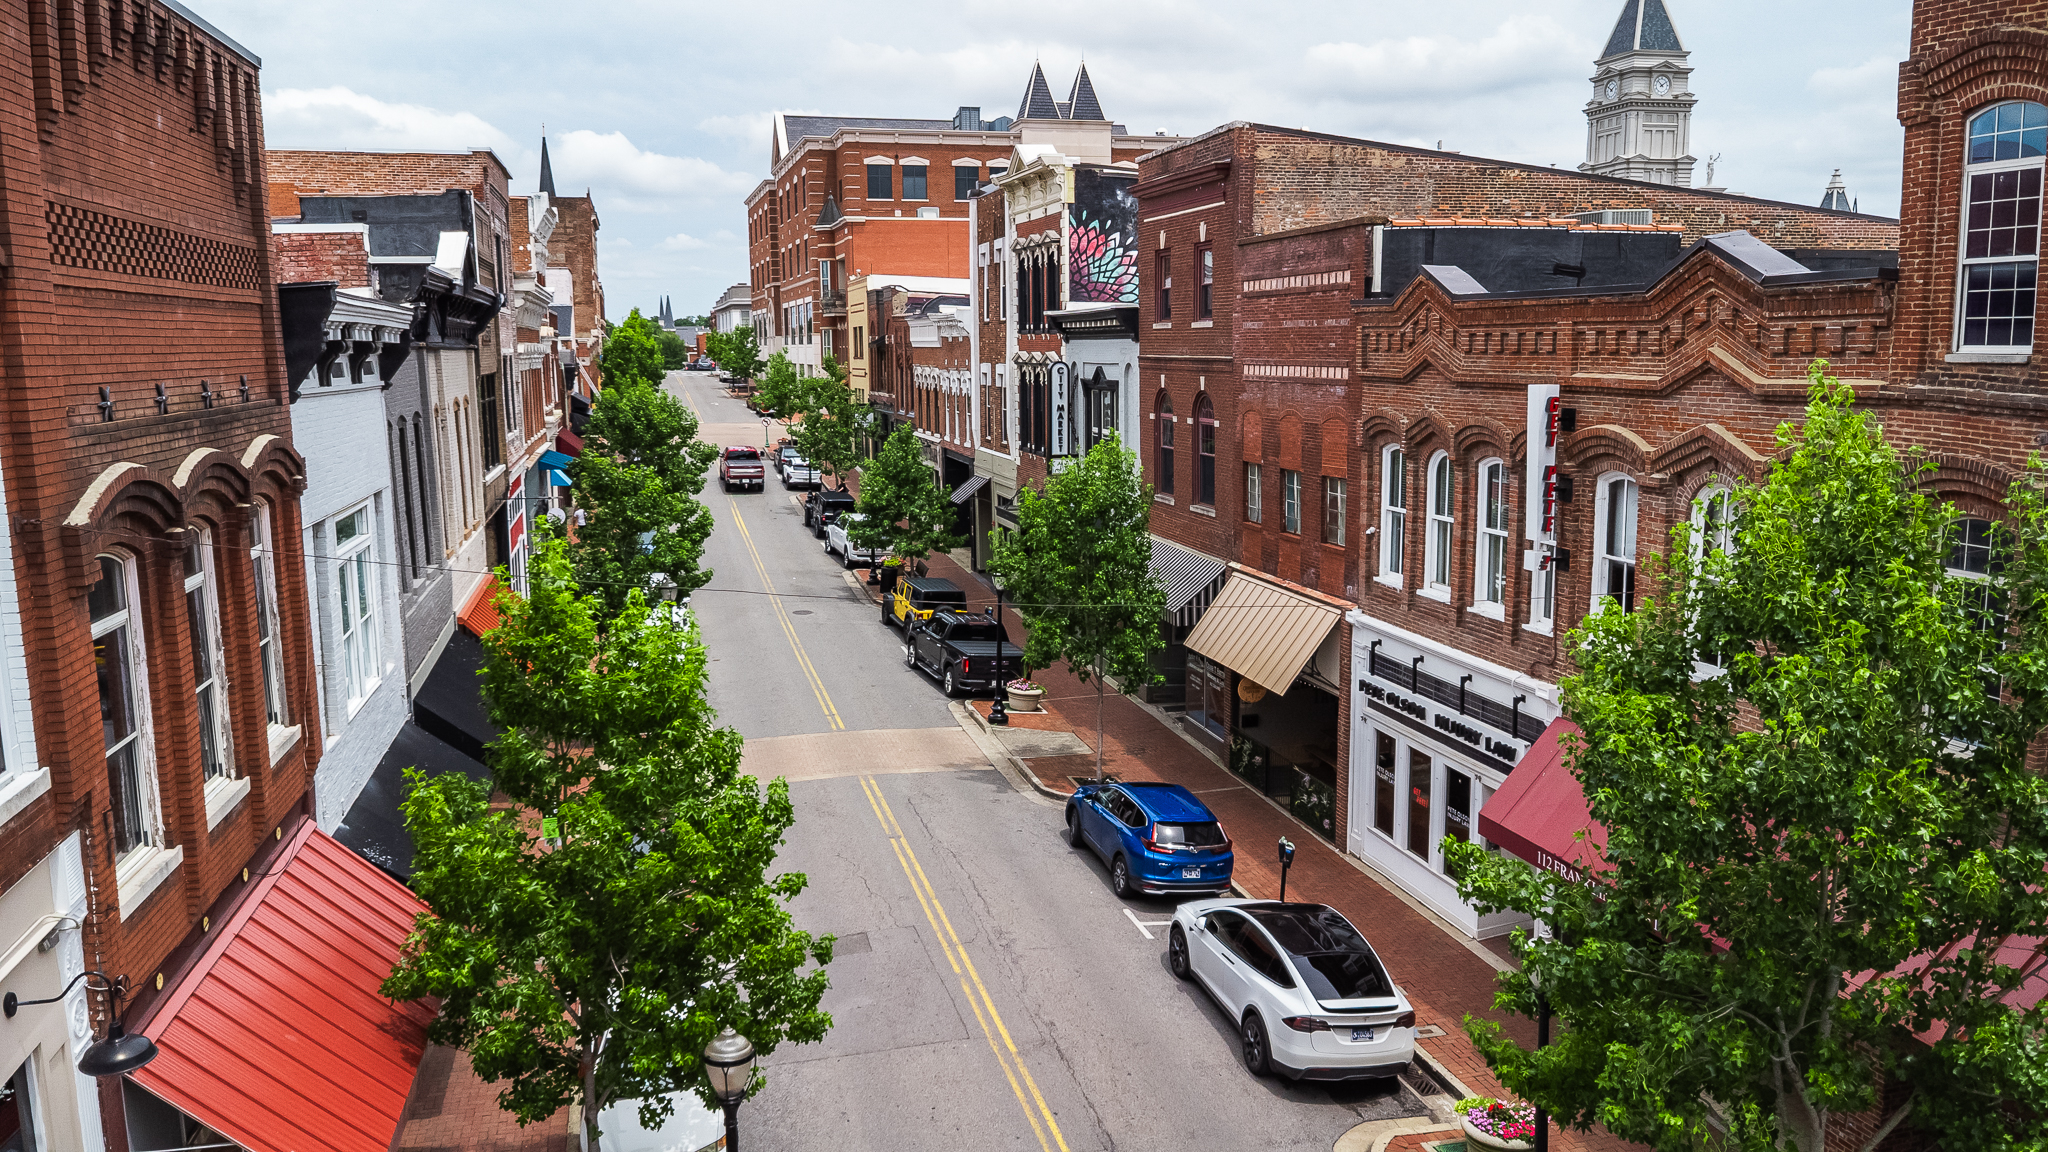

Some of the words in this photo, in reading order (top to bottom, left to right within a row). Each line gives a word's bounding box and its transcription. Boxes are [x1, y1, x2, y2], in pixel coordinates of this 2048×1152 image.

[1056, 404, 1064, 452] MARKET
[1546, 397, 1559, 447] GET
[1542, 466, 1557, 532] PETE
[1359, 679, 1385, 700] PETE
[1386, 692, 1426, 720] OLSON
[1434, 713, 1483, 746] INJURY
[1485, 737, 1517, 761] LAW
[1537, 851, 1552, 870] 112
